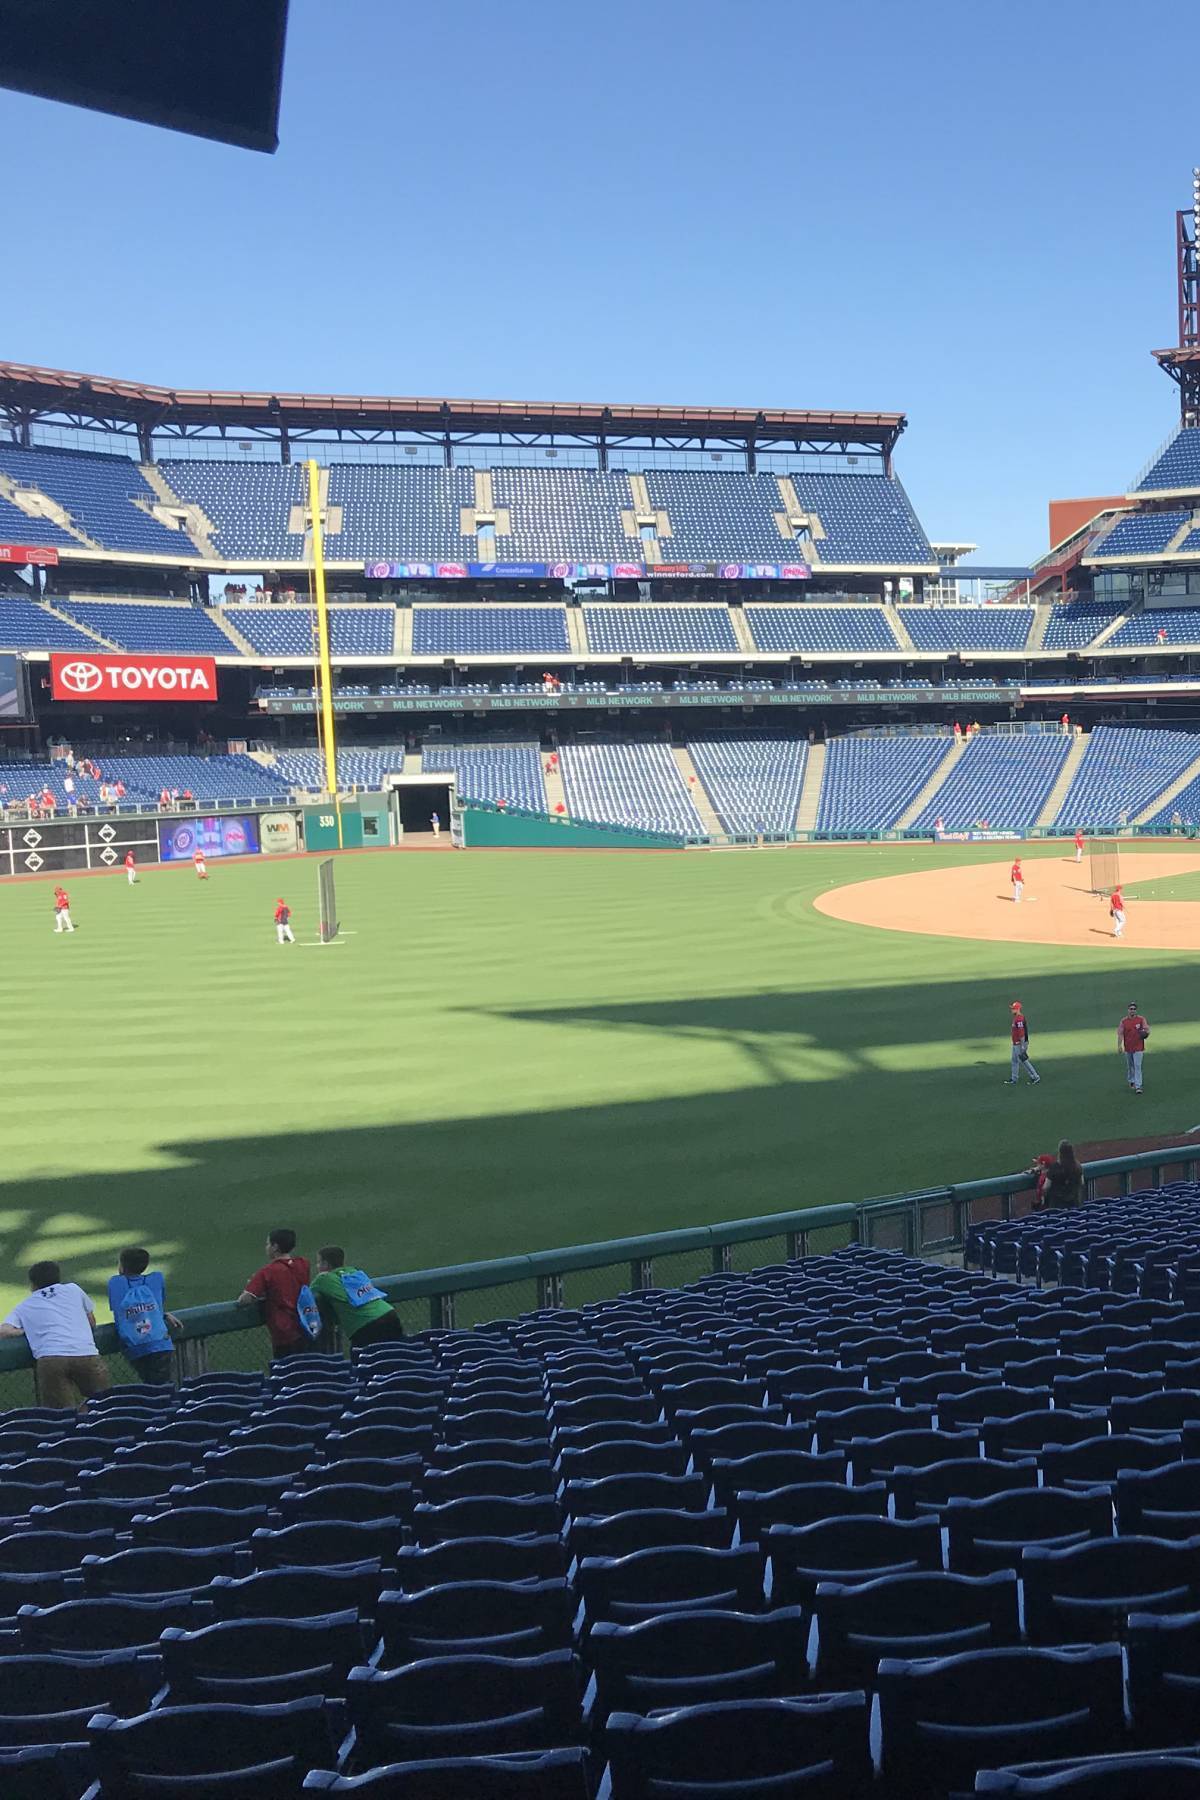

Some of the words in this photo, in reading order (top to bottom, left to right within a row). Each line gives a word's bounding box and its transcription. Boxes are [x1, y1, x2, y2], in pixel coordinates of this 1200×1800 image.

[106, 667, 209, 690] TOYOTA
[586, 696, 606, 705] MLB
[608, 696, 653, 705] NETWORK
[679, 695, 699, 704] MLB
[700, 695, 744, 703] NETWORK
[769, 694, 788, 702] MLB
[790, 693, 832, 702] NETWORK
[857, 693, 875, 702] MLB
[876, 692, 918, 701] NETWORK
[941, 692, 959, 701] MLB
[960, 692, 1001, 700] NETWORK
[292, 702, 313, 711] MLB
[316, 701, 364, 710] NWORK
[393, 700, 414, 709] MLB
[416, 699, 463, 709] NETWORK
[491, 698, 511, 707] MLB
[513, 698, 560, 706] NETWORK
[319, 815, 335, 828] 330
[266, 823, 289, 833] WM
[126, 1302, 156, 1319] Phillies
